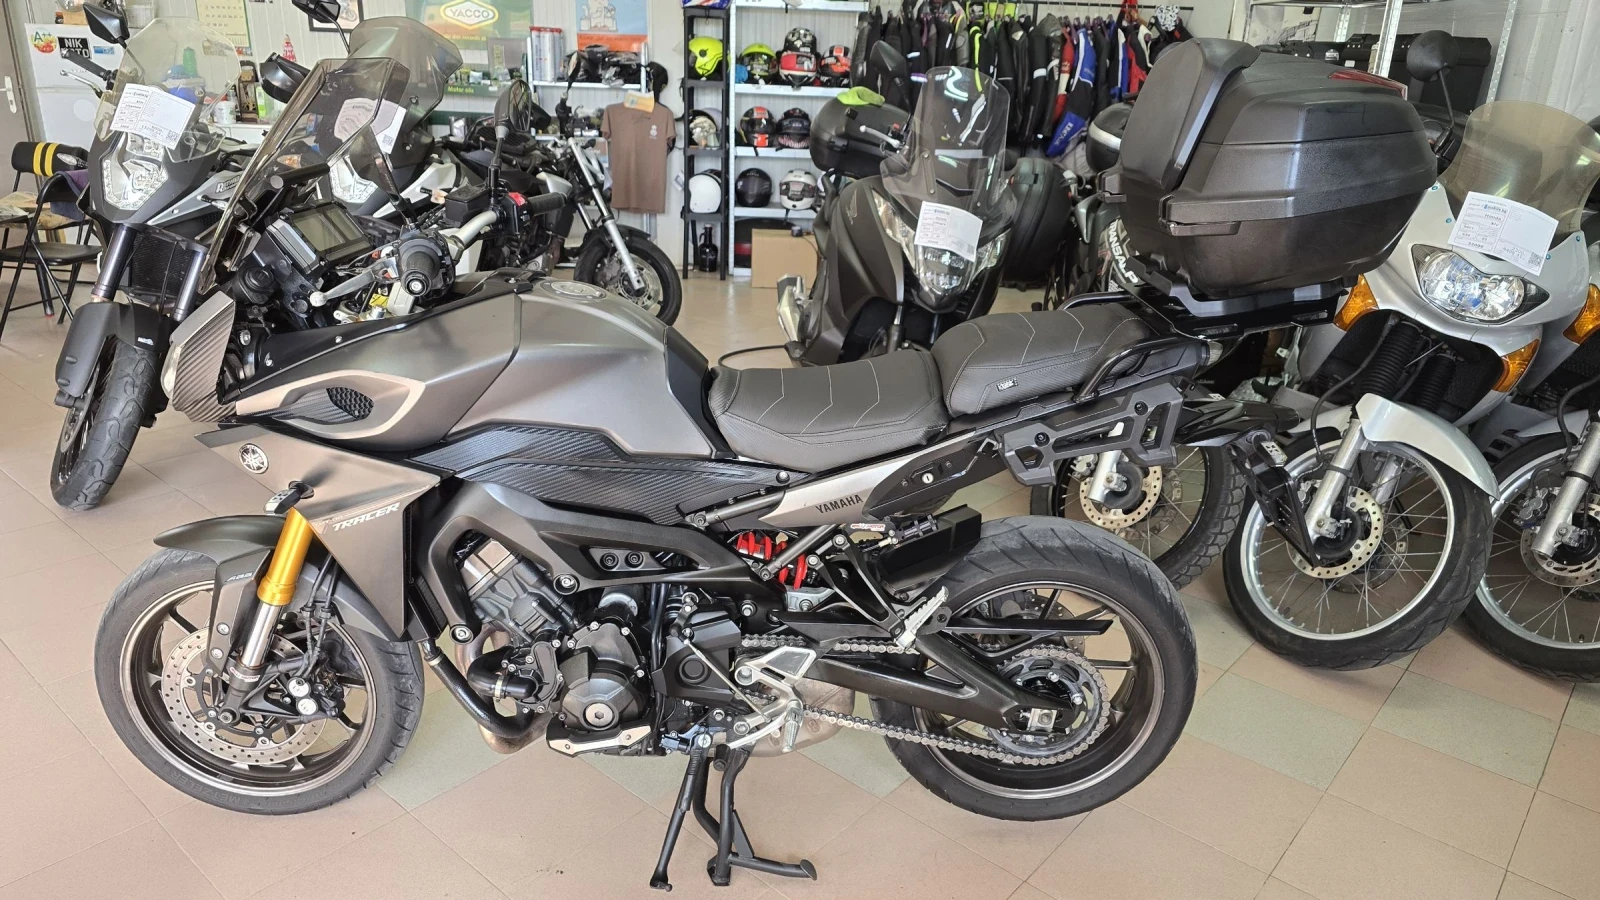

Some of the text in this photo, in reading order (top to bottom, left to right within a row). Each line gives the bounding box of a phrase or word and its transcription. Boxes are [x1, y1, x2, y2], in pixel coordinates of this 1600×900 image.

[449, 8, 490, 19] YACCO
[64, 38, 83, 48] NIK
[815, 494, 864, 514] YAMAHA
[332, 502, 400, 532] TRACER
